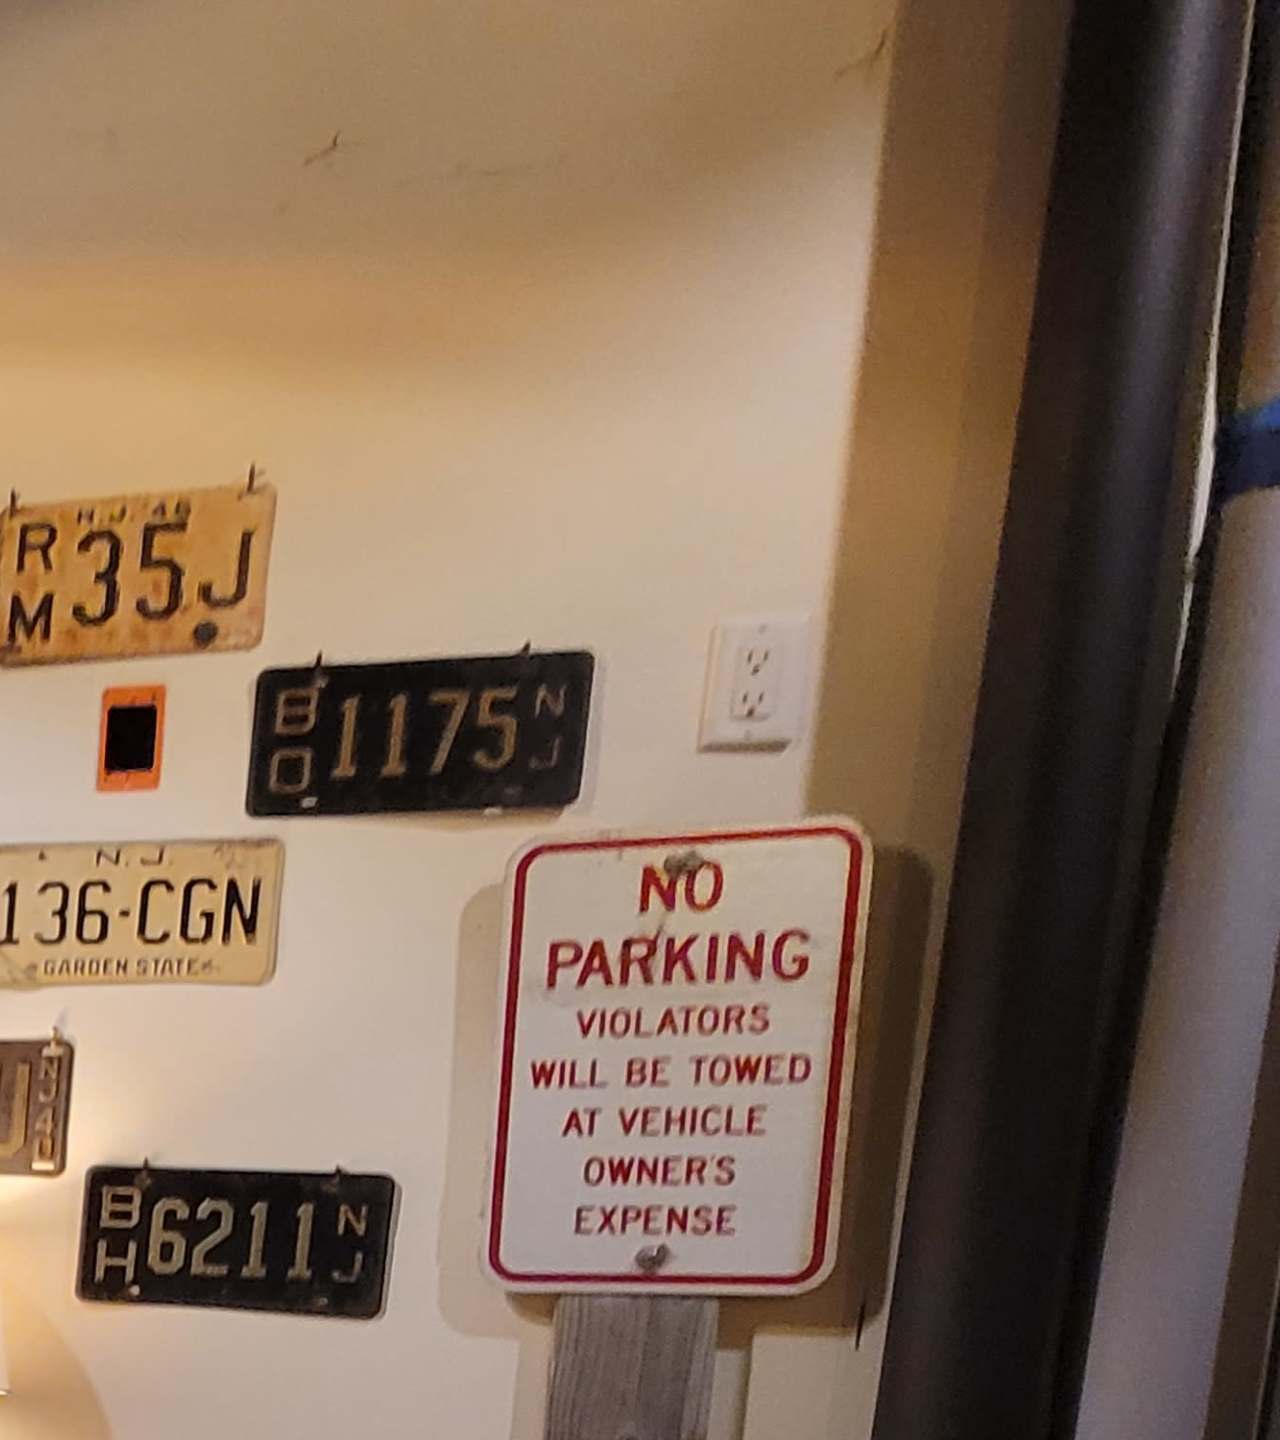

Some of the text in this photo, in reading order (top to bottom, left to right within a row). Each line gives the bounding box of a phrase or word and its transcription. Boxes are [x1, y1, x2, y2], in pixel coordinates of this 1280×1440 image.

[72, 521, 255, 628] 35J
[329, 685, 519, 779] 1175
[639, 861, 725, 917] NO
[43, 957, 201, 978] GARDEN STATE
[546, 929, 812, 990] PARKING
[577, 1003, 771, 1040] VIOLATORS
[530, 1053, 813, 1090] WILL BE TOWED
[562, 1105, 769, 1138] AT VEHICLE
[583, 1155, 736, 1187] OWNER'S
[573, 1204, 737, 1236] EXPENSE
[146, 1196, 316, 1283] 6211
